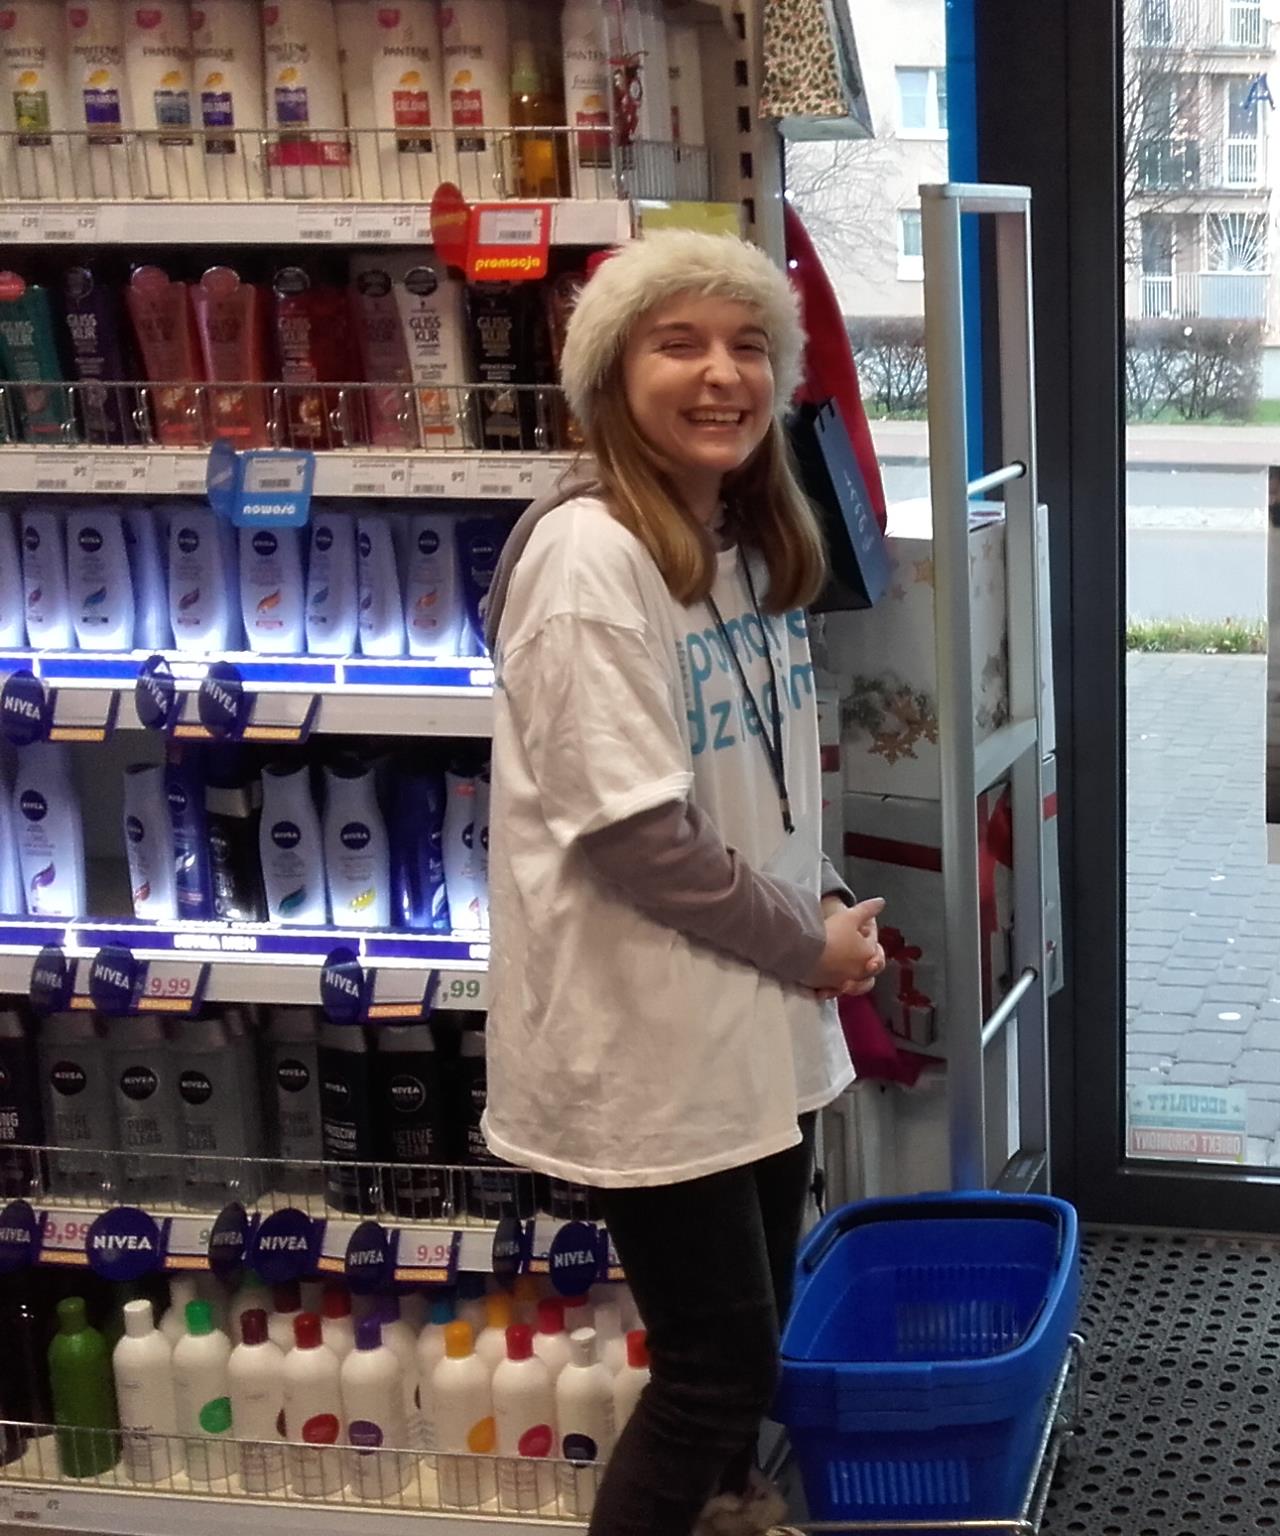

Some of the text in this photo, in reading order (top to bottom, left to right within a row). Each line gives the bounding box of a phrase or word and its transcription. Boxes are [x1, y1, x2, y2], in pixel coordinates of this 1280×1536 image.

[474, 255, 541, 271] promocja
[409, 316, 441, 331] GLISS
[414, 330, 440, 343] KUR
[4, 693, 41, 720] NIVEA
[203, 679, 238, 718] NIVEA
[95, 963, 130, 990] NIVEA
[325, 970, 360, 998] NIVEA
[151, 978, 191, 997] 9,99
[391, 1086, 421, 1096] NIVEA
[93, 1234, 152, 1250] NIVEA
[259, 1236, 308, 1250] NIVEA
[350, 1249, 385, 1266] NIVEA
[553, 1250, 595, 1269] NIVEA
